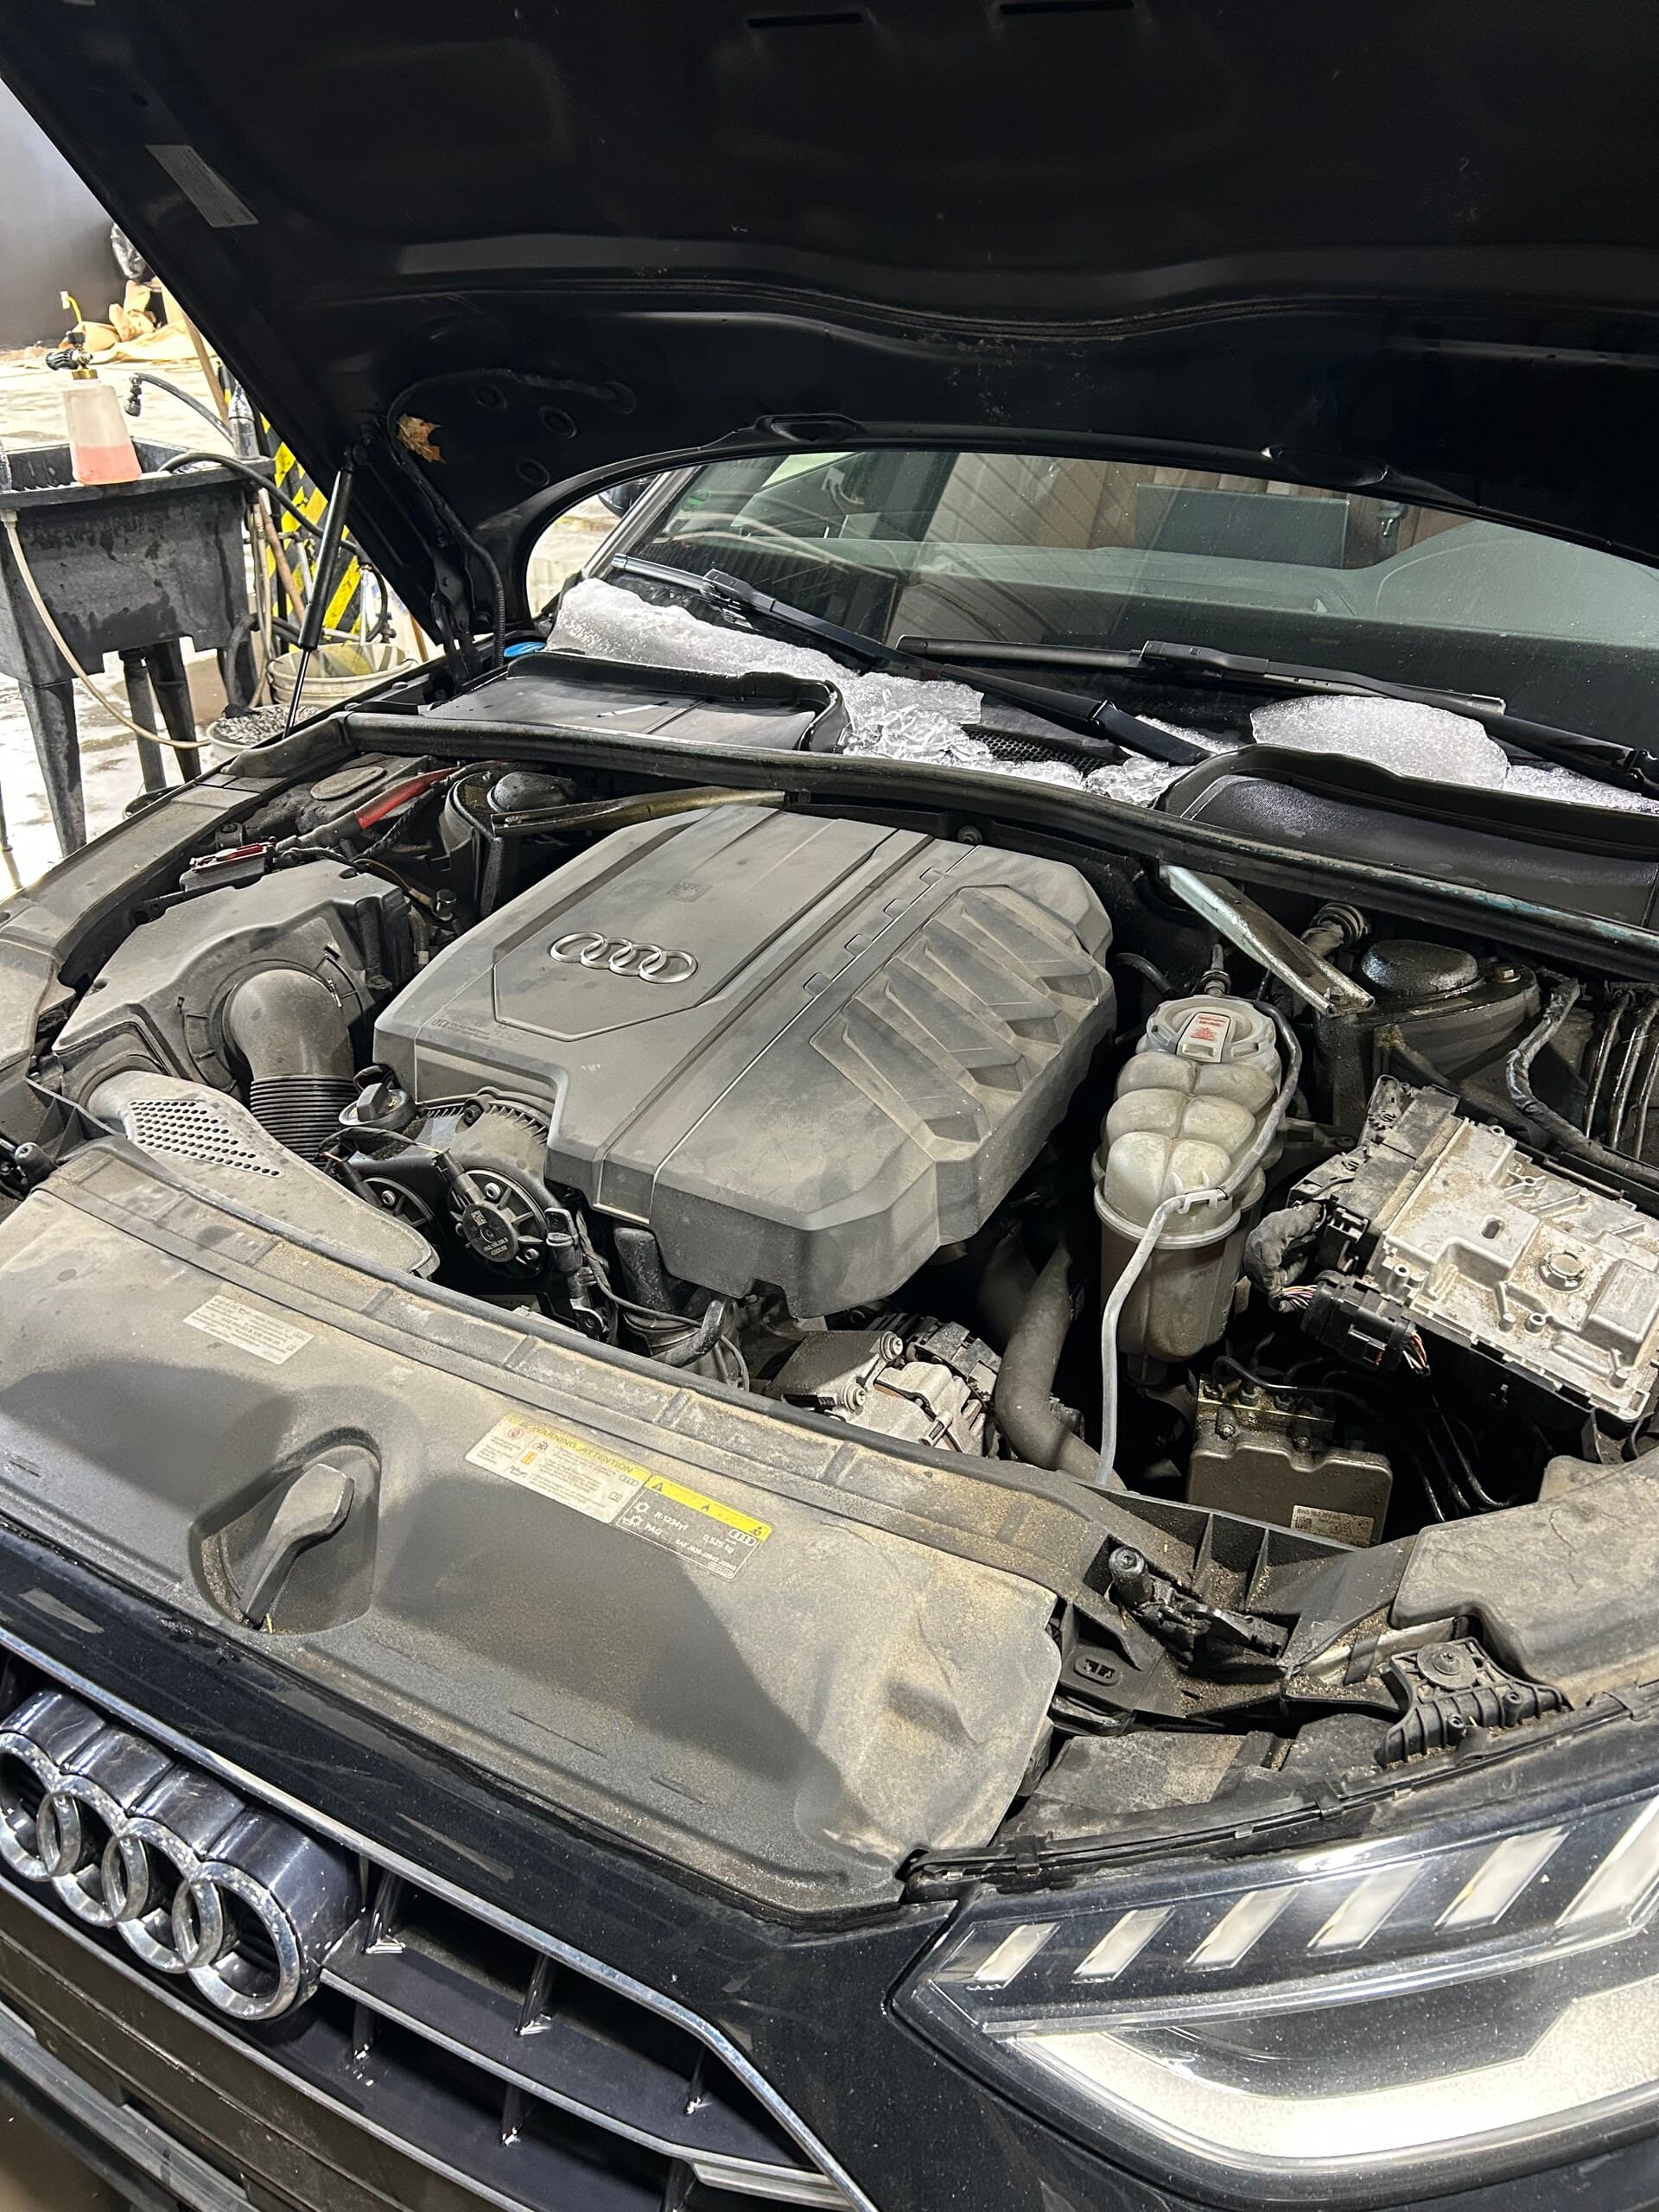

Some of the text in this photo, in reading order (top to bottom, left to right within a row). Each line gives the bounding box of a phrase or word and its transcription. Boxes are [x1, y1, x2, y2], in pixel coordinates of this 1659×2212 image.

[580, 1446, 633, 1474] ATTENTION
[644, 1522, 663, 1536] PAG
[723, 1542, 734, 1555] kg
